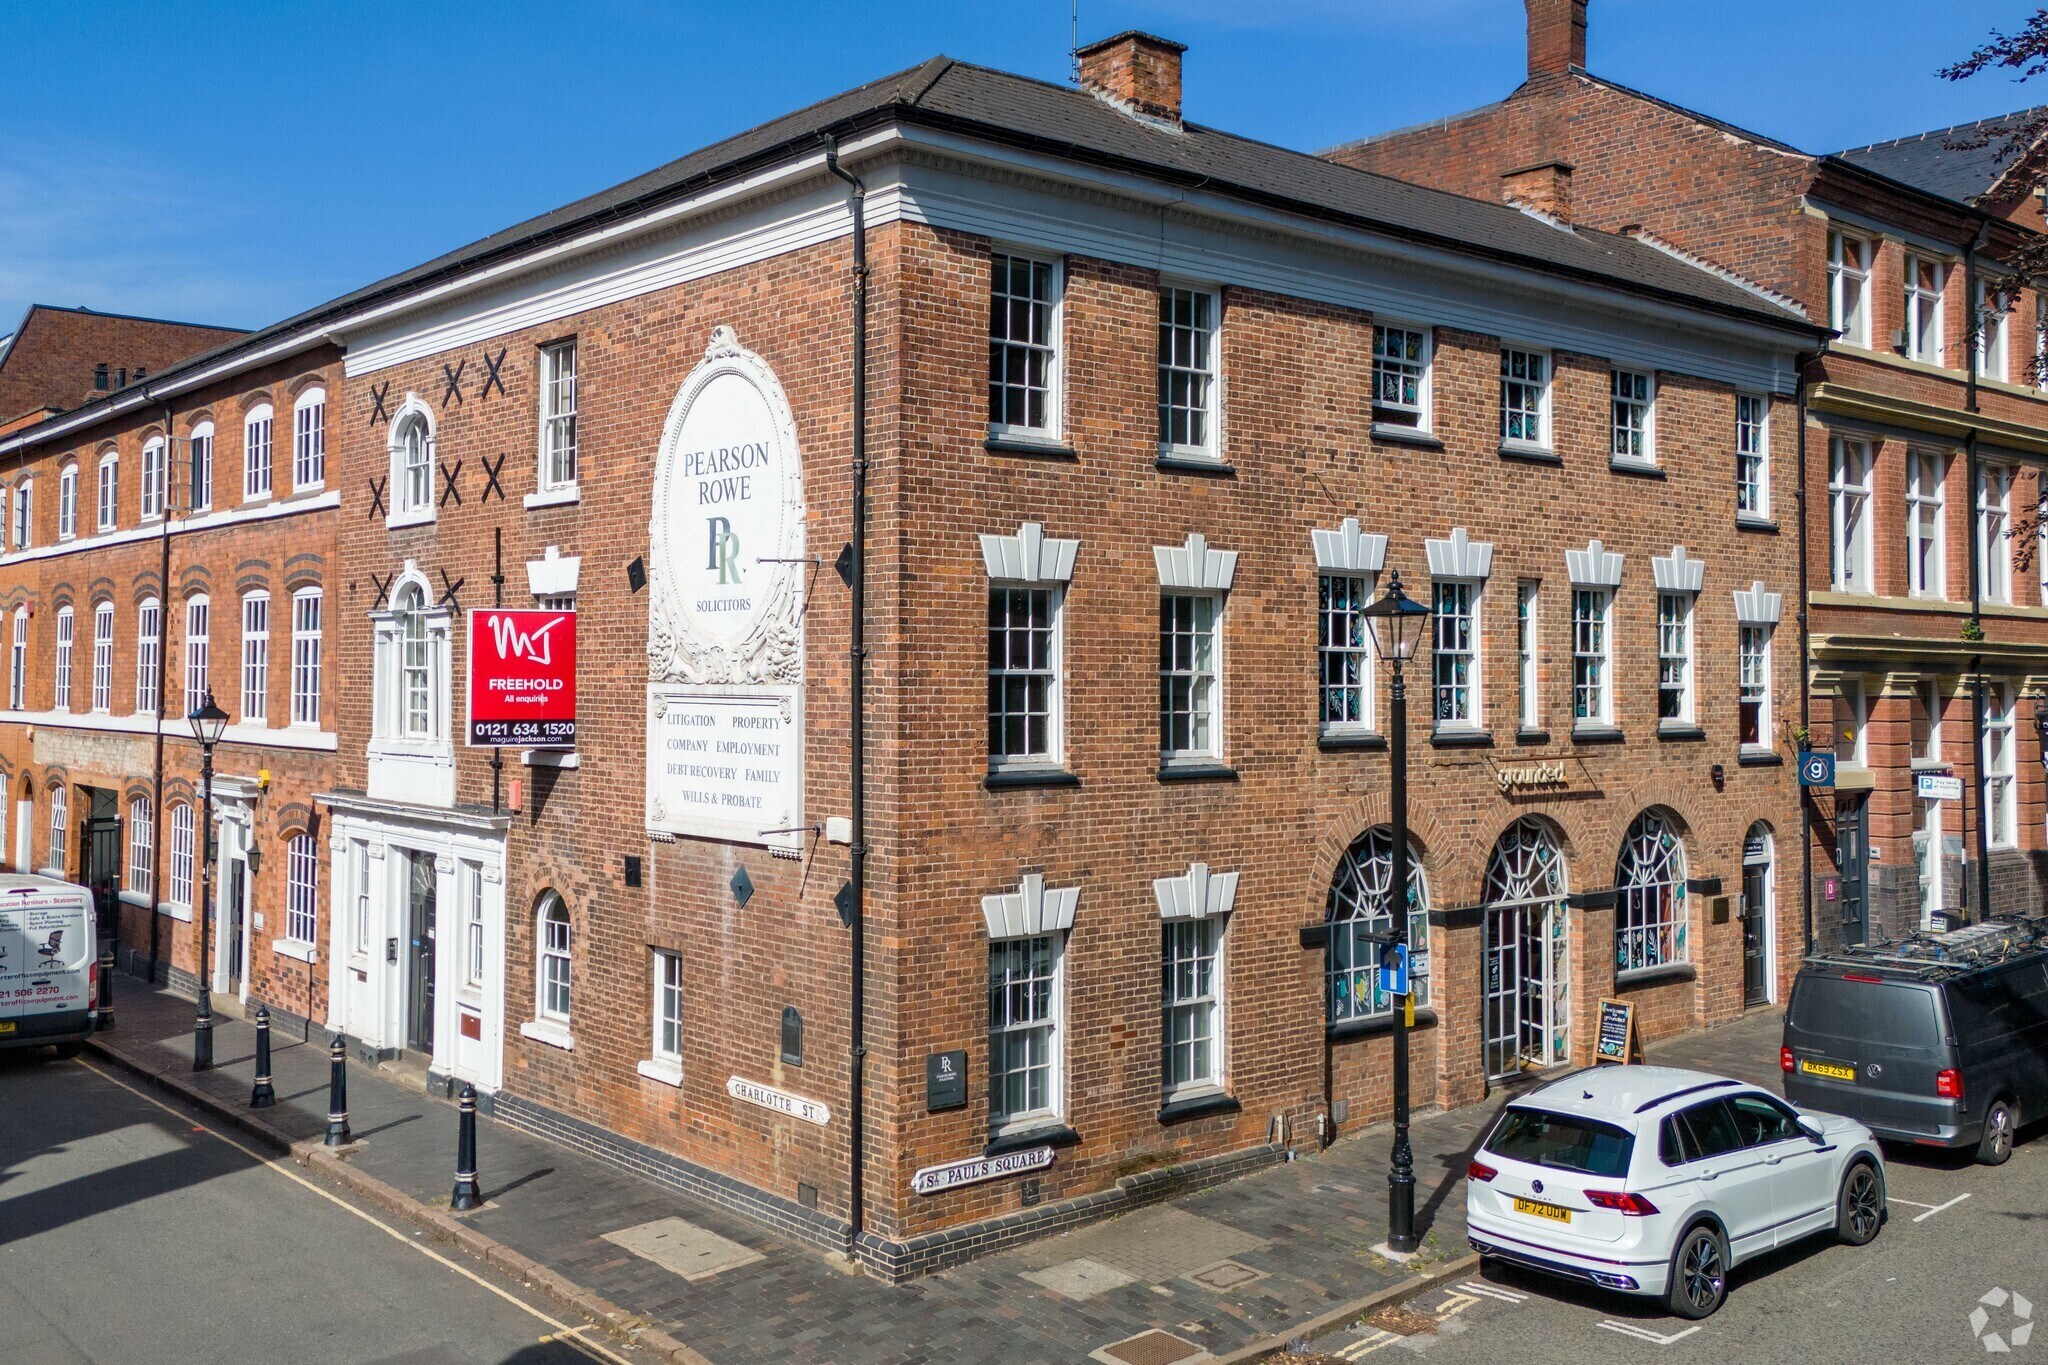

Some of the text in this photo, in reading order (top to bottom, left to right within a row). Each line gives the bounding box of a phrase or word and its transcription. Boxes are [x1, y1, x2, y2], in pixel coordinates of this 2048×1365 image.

[684, 441, 770, 478] PEARSON
[698, 475, 752, 505] ROWE
[696, 598, 751, 612] SOLICITORS
[489, 678, 563, 690] FREEHOLD
[516, 695, 548, 703] enquiries
[476, 723, 575, 735] 0121 634 1520
[667, 714, 781, 730] LITIGATION PROPERTY
[490, 735, 562, 744] maguirejackson.com
[667, 738, 780, 757] COMPANY EMPLOYMENT
[667, 763, 781, 783] DEBT RECOVERY FAMILY
[1811, 762, 1822, 778] g
[682, 790, 762, 809] WILLS & PROBATE
[15, 988, 33, 997] 506
[36, 986, 60, 995] 2270
[1831, 1066, 1849, 1077] ZSX
[735, 1083, 815, 1119] CHARLOTTE ST
[948, 1163, 989, 1184] PAUL'S
[995, 1150, 1044, 1173] SQUARE
[1518, 1199, 1567, 1220] DF72 UDW
